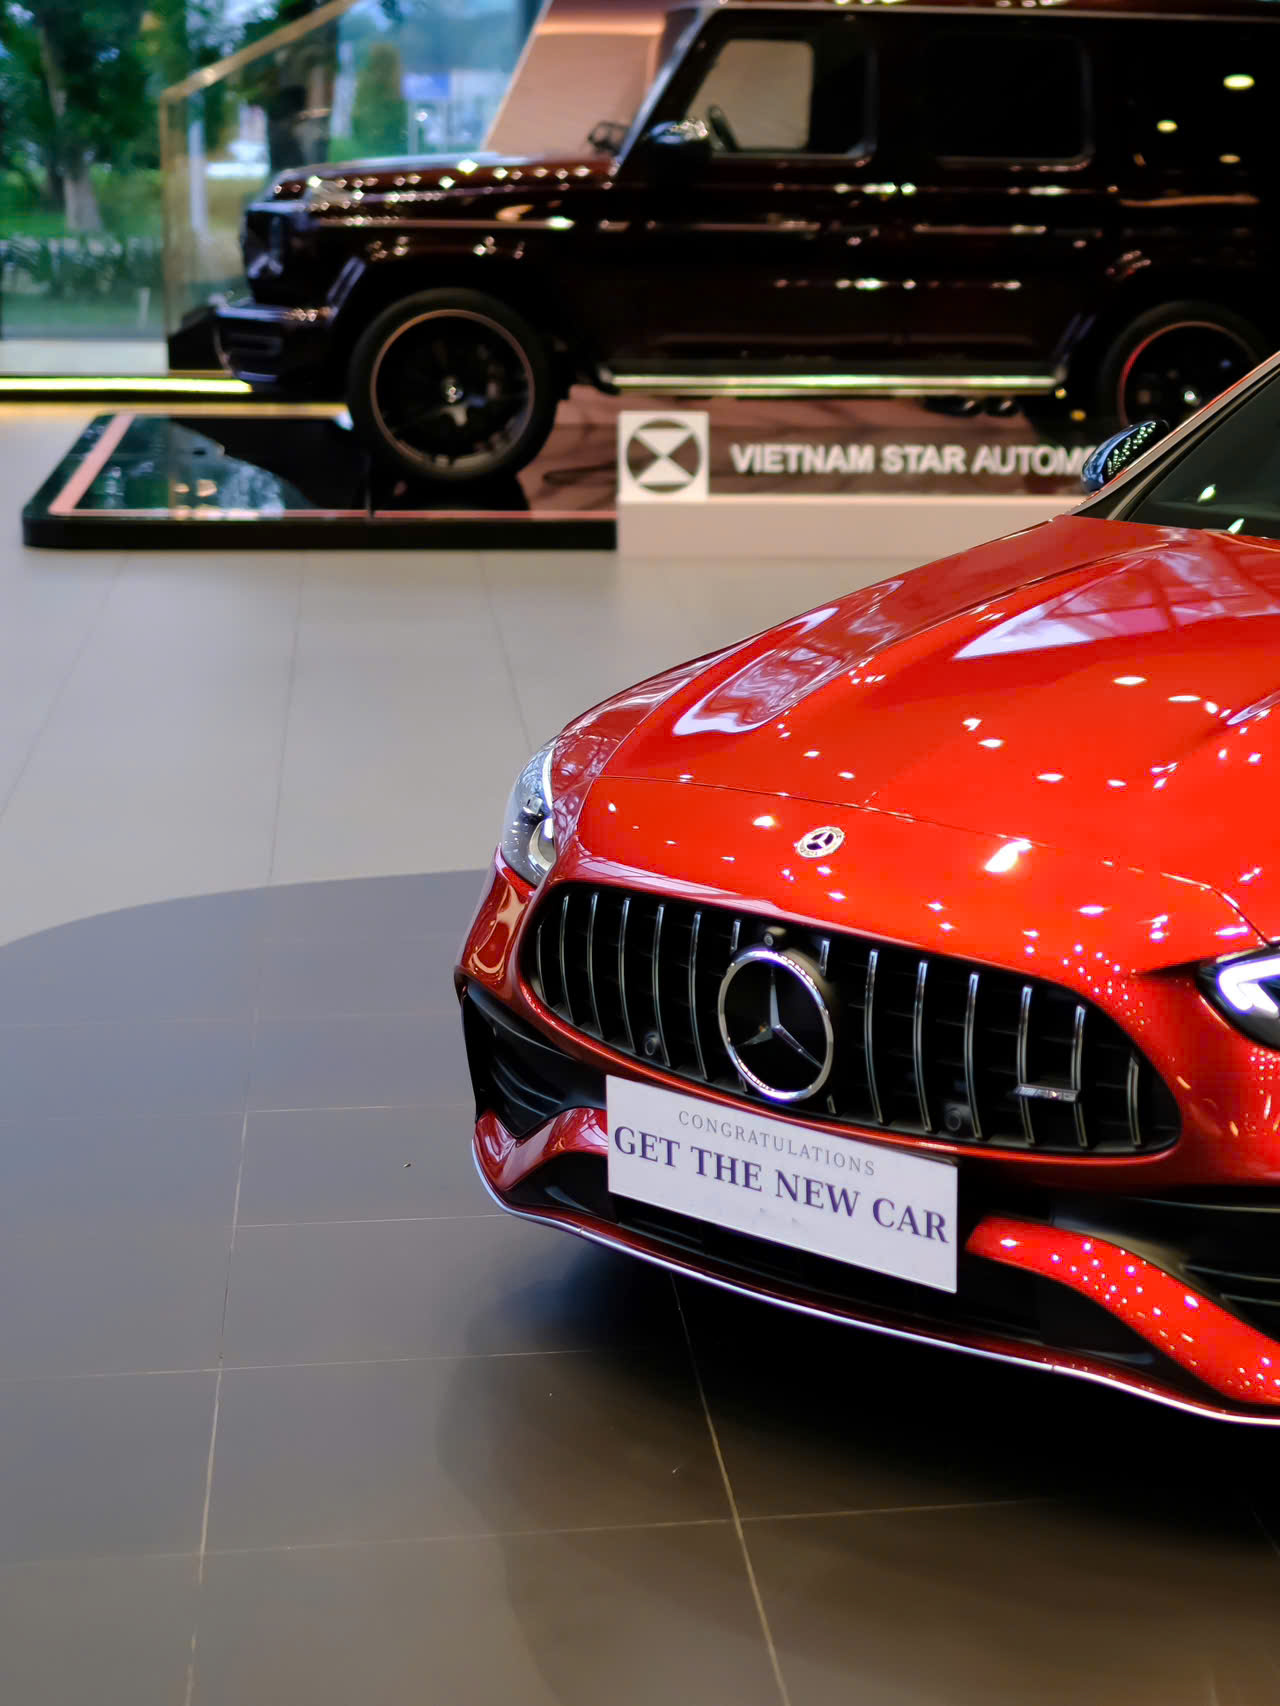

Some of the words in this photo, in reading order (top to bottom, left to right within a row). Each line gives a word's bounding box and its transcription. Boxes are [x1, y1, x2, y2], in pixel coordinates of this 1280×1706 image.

[730, 443, 874, 475] VIETNAM
[881, 444, 966, 475] STAR
[972, 445, 1092, 475] AUTOM
[678, 1110, 876, 1176] CONGRATULATIONS
[614, 1126, 681, 1168] GET
[690, 1146, 763, 1192] THE
[775, 1170, 861, 1218] NEW
[872, 1197, 950, 1244] CAR
